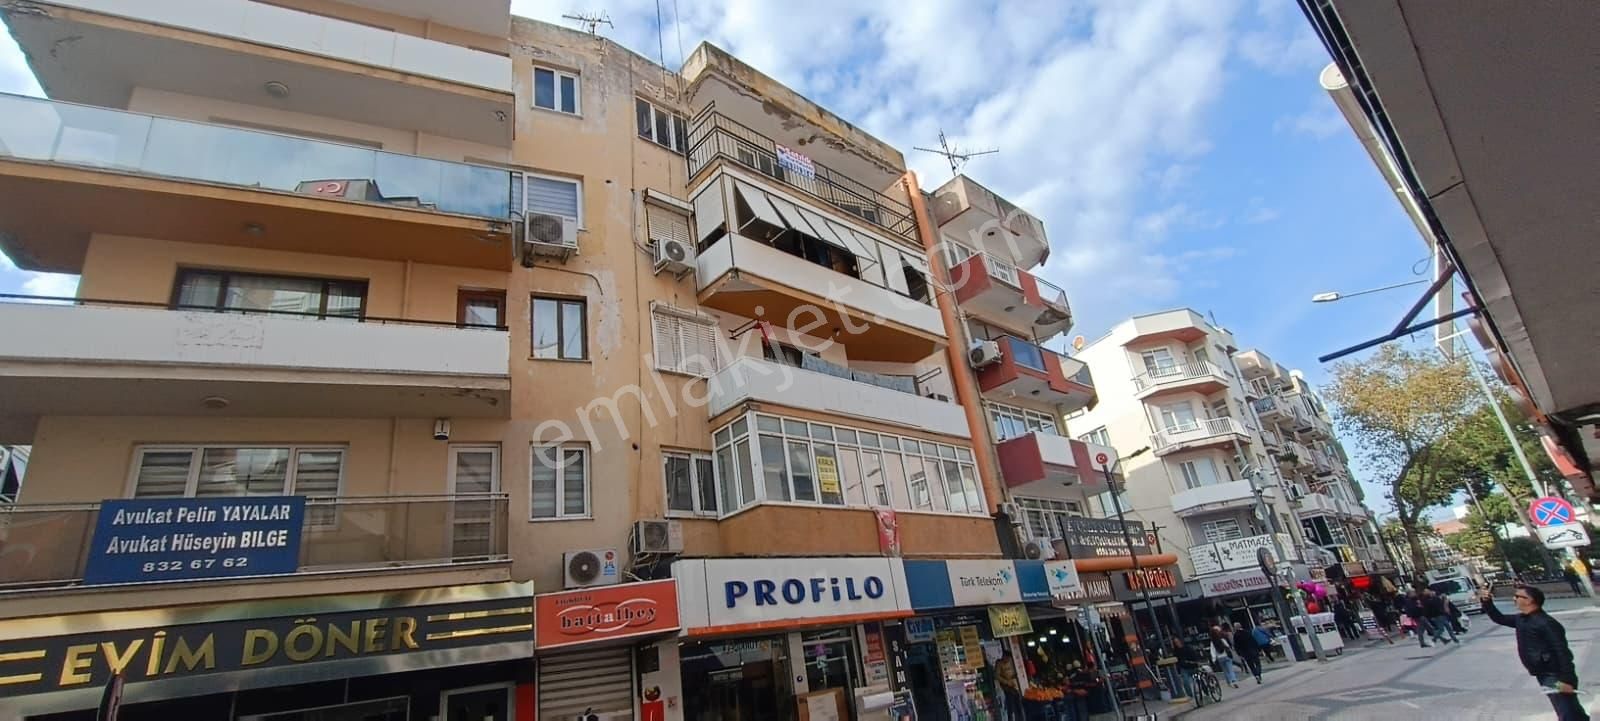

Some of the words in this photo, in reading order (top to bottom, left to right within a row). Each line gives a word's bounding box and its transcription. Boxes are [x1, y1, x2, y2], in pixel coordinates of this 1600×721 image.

[112, 508, 173, 526] Avukat
[176, 507, 217, 523] Pelin
[222, 504, 291, 521] YAYALAR
[106, 535, 168, 554] Avukat
[171, 532, 236, 554] Hüseyin
[142, 561, 184, 572] 832
[190, 559, 216, 570] 67
[222, 557, 248, 568] 62
[959, 576, 976, 587] Türk
[976, 574, 1004, 587] Telekom
[242, 617, 419, 666] DÖNER
